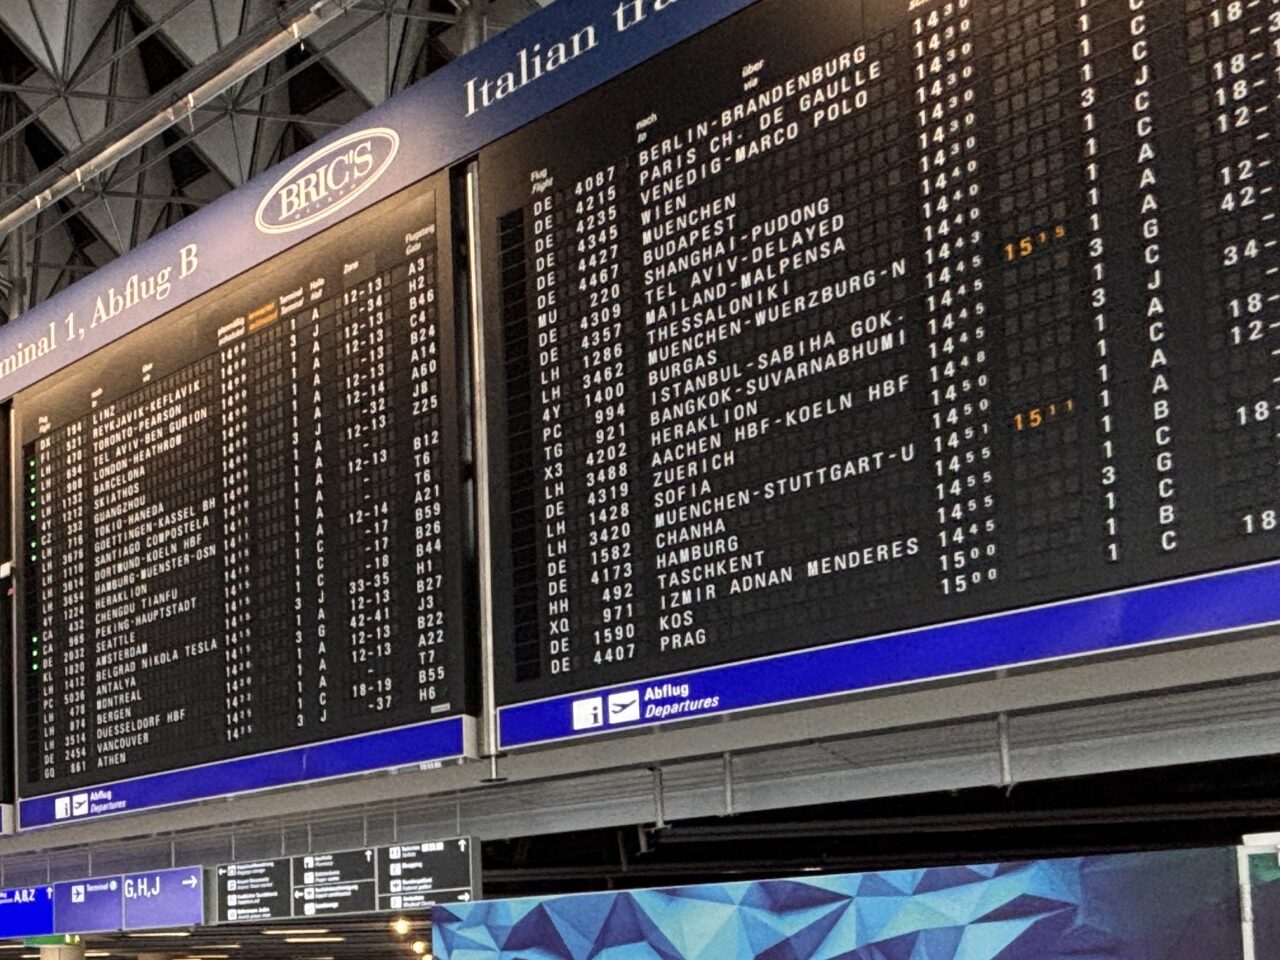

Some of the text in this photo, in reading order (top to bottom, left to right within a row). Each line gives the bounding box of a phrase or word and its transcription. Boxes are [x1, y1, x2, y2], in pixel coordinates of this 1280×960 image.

[463, 23, 599, 118] Italian
[574, 44, 866, 195] 4087 BERLIN-BRANDENBURG
[575, 185, 616, 214] 4215
[639, 147, 696, 186] PARIS
[759, 106, 783, 131] DE
[799, 60, 880, 112] GAULLE
[278, 140, 373, 221] BRIC'S
[575, 89, 867, 233] 4235 VENEDIG-MARCO POLO
[577, 192, 686, 252] 4345 WIEN
[577, 192, 736, 272] 4427 MUENCHEN
[578, 213, 736, 291] 4467 BUDAPEST
[90, 267, 171, 329] Abflug
[178, 243, 199, 280] B
[409, 288, 434, 310] B46
[537, 197, 829, 329] MU 220 SHANGHAI-PUDONG
[579, 214, 844, 330] 4309 TEL AVIV-DELAYED
[580, 236, 846, 349] 4357 MAILAND-MALPENSA
[582, 258, 905, 389] 3462 MUENCHEN-WUERZBURG-N
[582, 279, 788, 369] 1286 THESSALONIKI
[411, 358, 436, 380] A60
[542, 349, 717, 422] 4Y 1400 BURGAS
[542, 423, 562, 442] PC
[594, 402, 625, 424] 994
[651, 330, 835, 405] ISTANBUL-SABIHA
[543, 328, 905, 460] TG 921 BANGKOK-SUVARNABHUMI
[585, 399, 757, 466] 4202 HERAKLION
[586, 374, 908, 487] 3488 AACHEN HBF-KOELN HBF
[587, 449, 734, 506] 4319 ZUERICH
[589, 443, 914, 546] 3420 MUENCHEN-STUTTGART-U
[589, 478, 711, 526] 1428 SOFIA
[590, 535, 738, 584] 4173 HAMBURG
[591, 541, 631, 565] 1582
[601, 550, 764, 602] 492 TASCHKENT
[602, 602, 632, 623] 971
[660, 583, 716, 610] IZMIR
[729, 566, 792, 594] ADNAN
[806, 537, 918, 577] MENDERES
[593, 609, 693, 645] 1590 KOS
[593, 628, 706, 664] 4407 PRAG
[644, 683, 689, 702] Abflug
[645, 696, 720, 718] Departures
[125, 877, 160, 899] G,H,J
